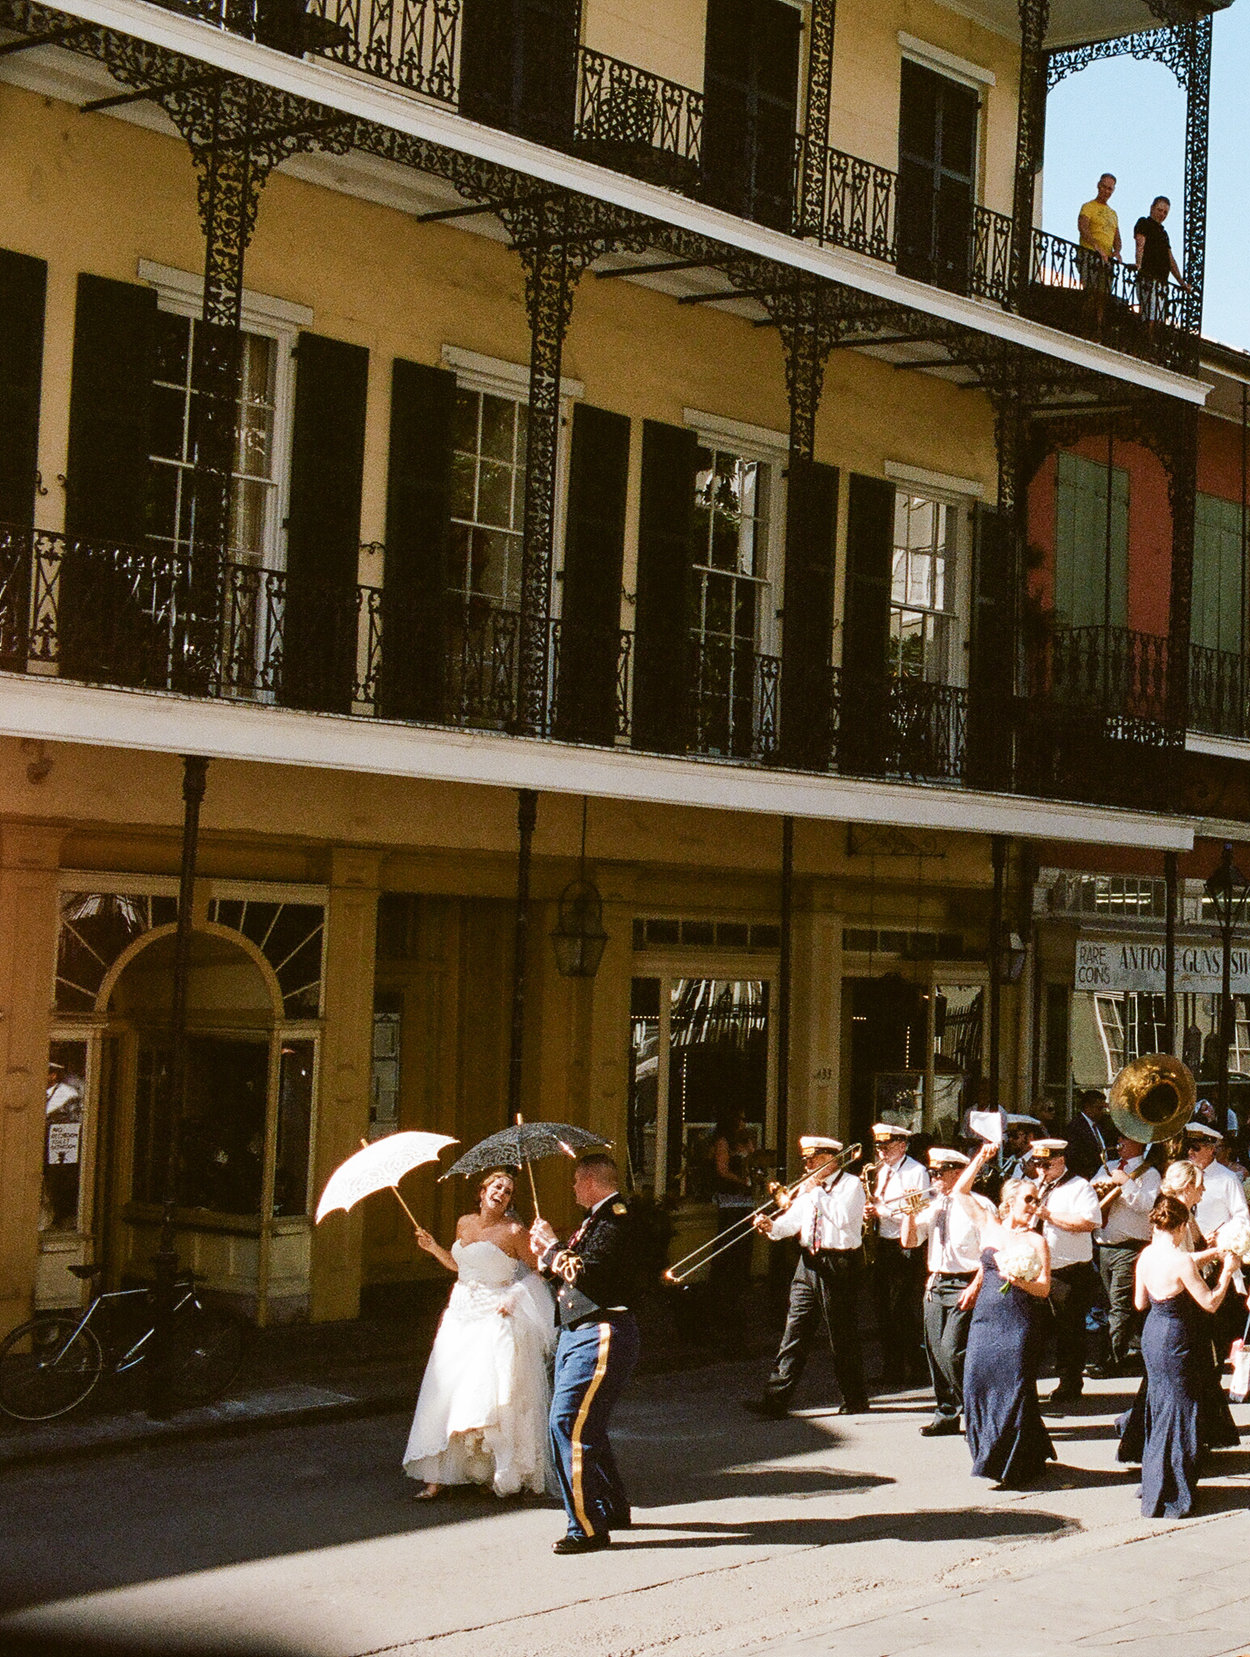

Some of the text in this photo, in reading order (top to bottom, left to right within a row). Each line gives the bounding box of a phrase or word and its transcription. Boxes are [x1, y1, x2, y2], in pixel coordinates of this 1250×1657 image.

[1079, 945, 1107, 966] RARE
[1182, 947, 1220, 974] GUNS
[1078, 965, 1111, 985] COINS
